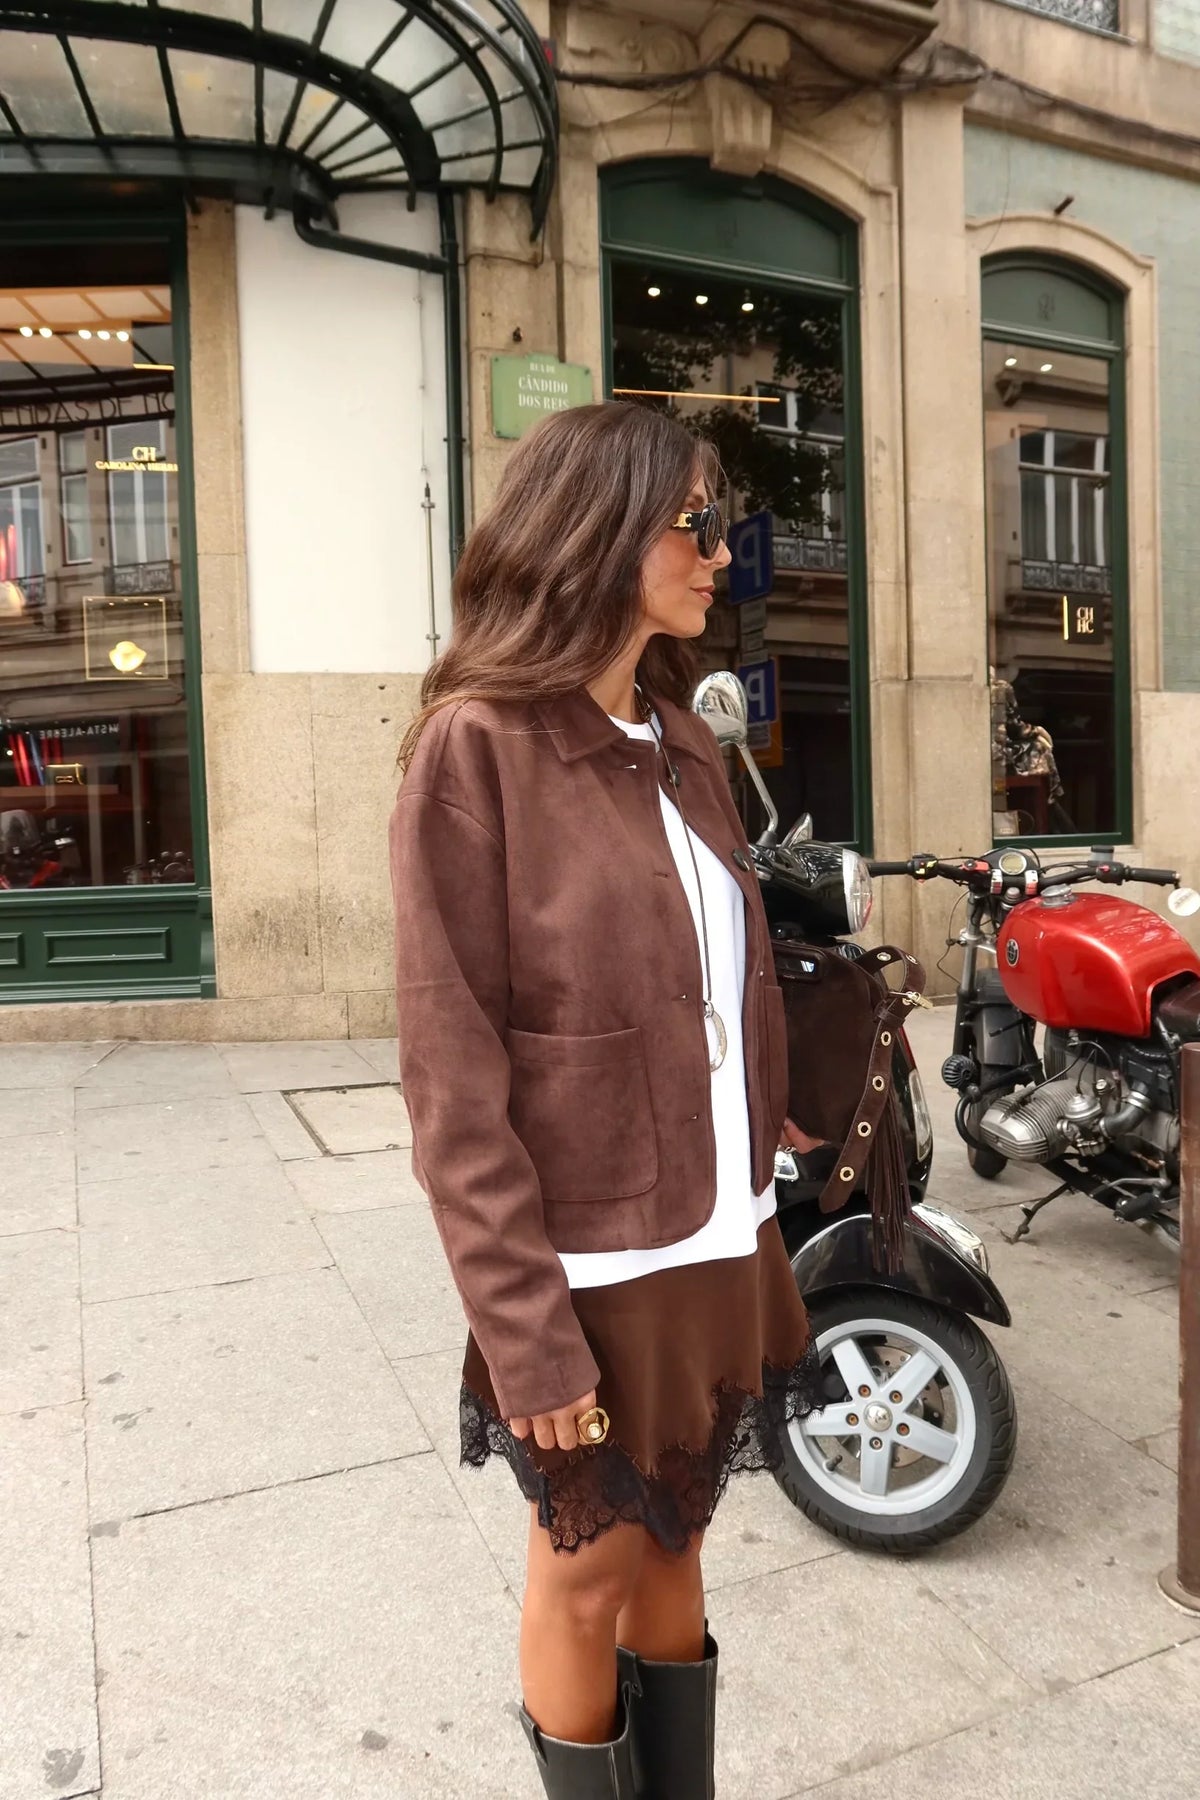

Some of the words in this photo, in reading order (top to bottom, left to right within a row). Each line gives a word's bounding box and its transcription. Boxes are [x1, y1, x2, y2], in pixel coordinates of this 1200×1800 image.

[518, 374, 568, 394] CÂNDIDO
[518, 393, 541, 408] DOS
[543, 396, 570, 410] REIS
[132, 446, 157, 461] CH
[95, 461, 146, 471] CAROLINA
